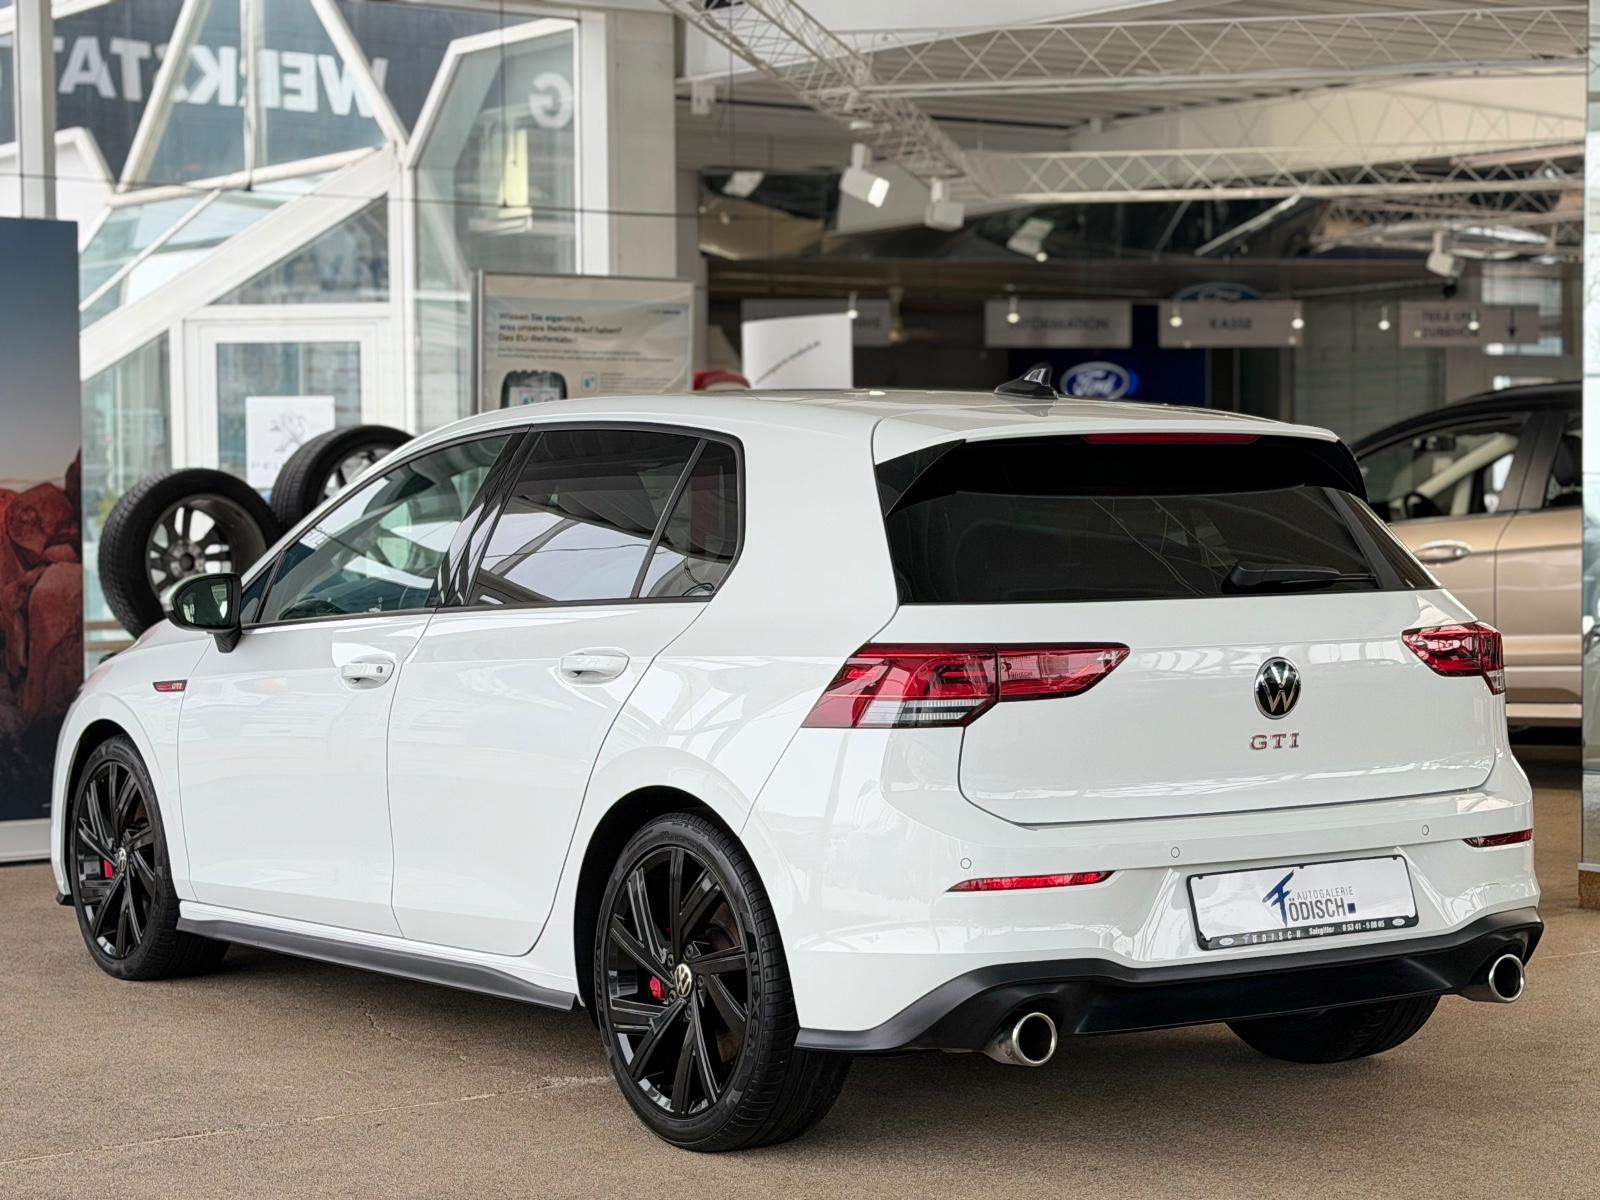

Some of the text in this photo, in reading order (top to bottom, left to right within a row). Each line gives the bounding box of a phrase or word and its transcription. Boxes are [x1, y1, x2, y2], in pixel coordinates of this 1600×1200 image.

[1249, 733, 1300, 750] GTI
[1296, 886, 1354, 901] AUTOGALERIE
[746, 951, 761, 1058] NEXEN
